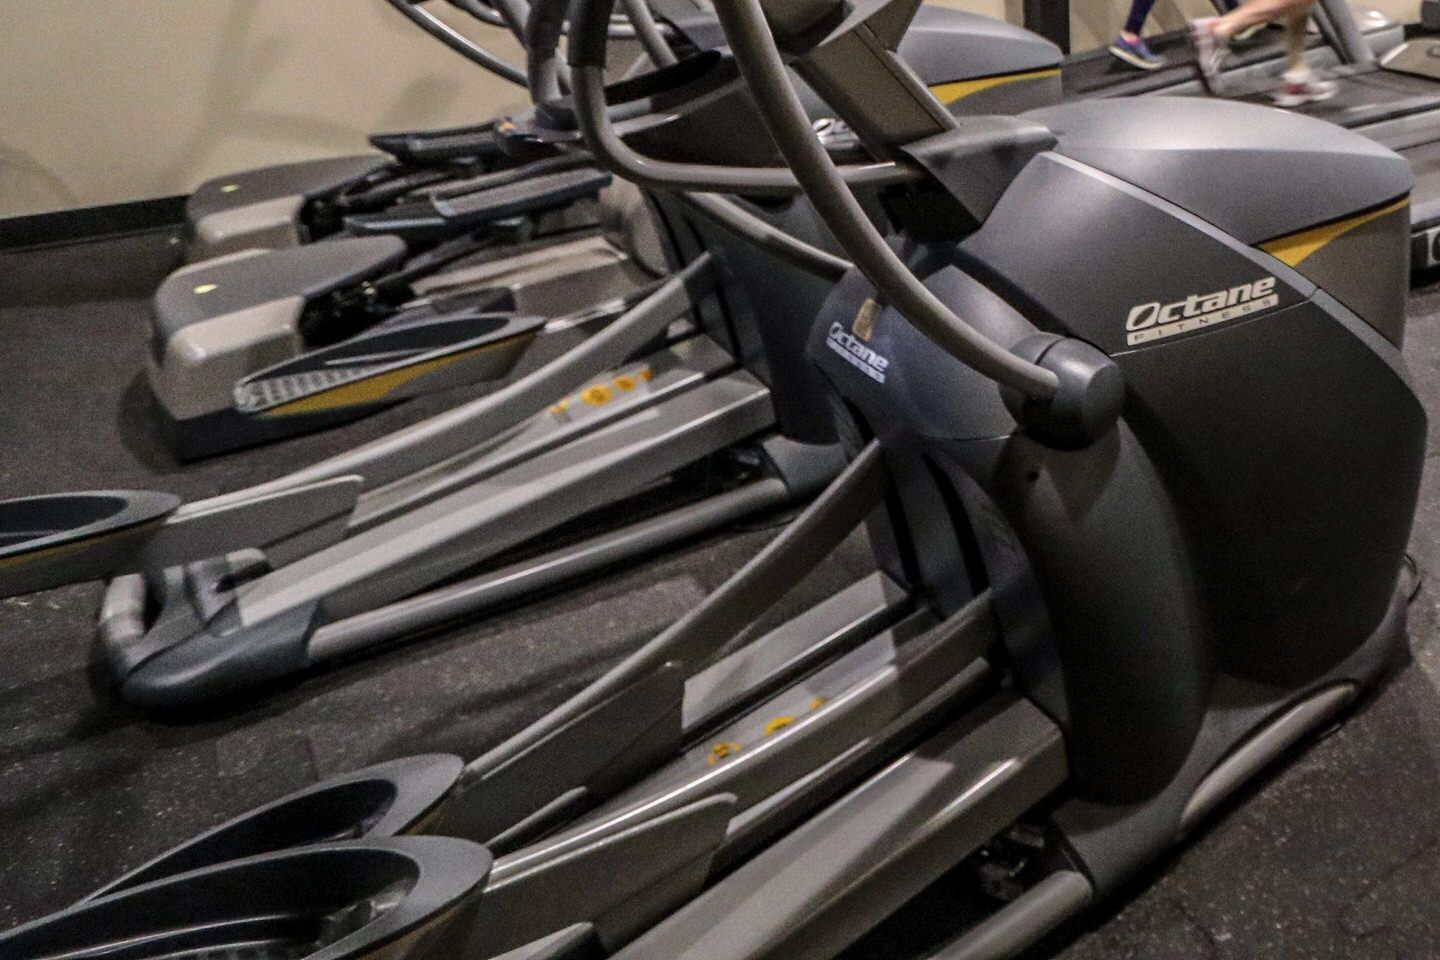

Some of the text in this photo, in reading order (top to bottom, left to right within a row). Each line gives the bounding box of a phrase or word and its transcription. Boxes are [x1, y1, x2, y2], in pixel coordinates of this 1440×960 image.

[1126, 277, 1276, 331] Octane
[1133, 297, 1273, 342] FITNESS
[829, 321, 889, 372] Octane
